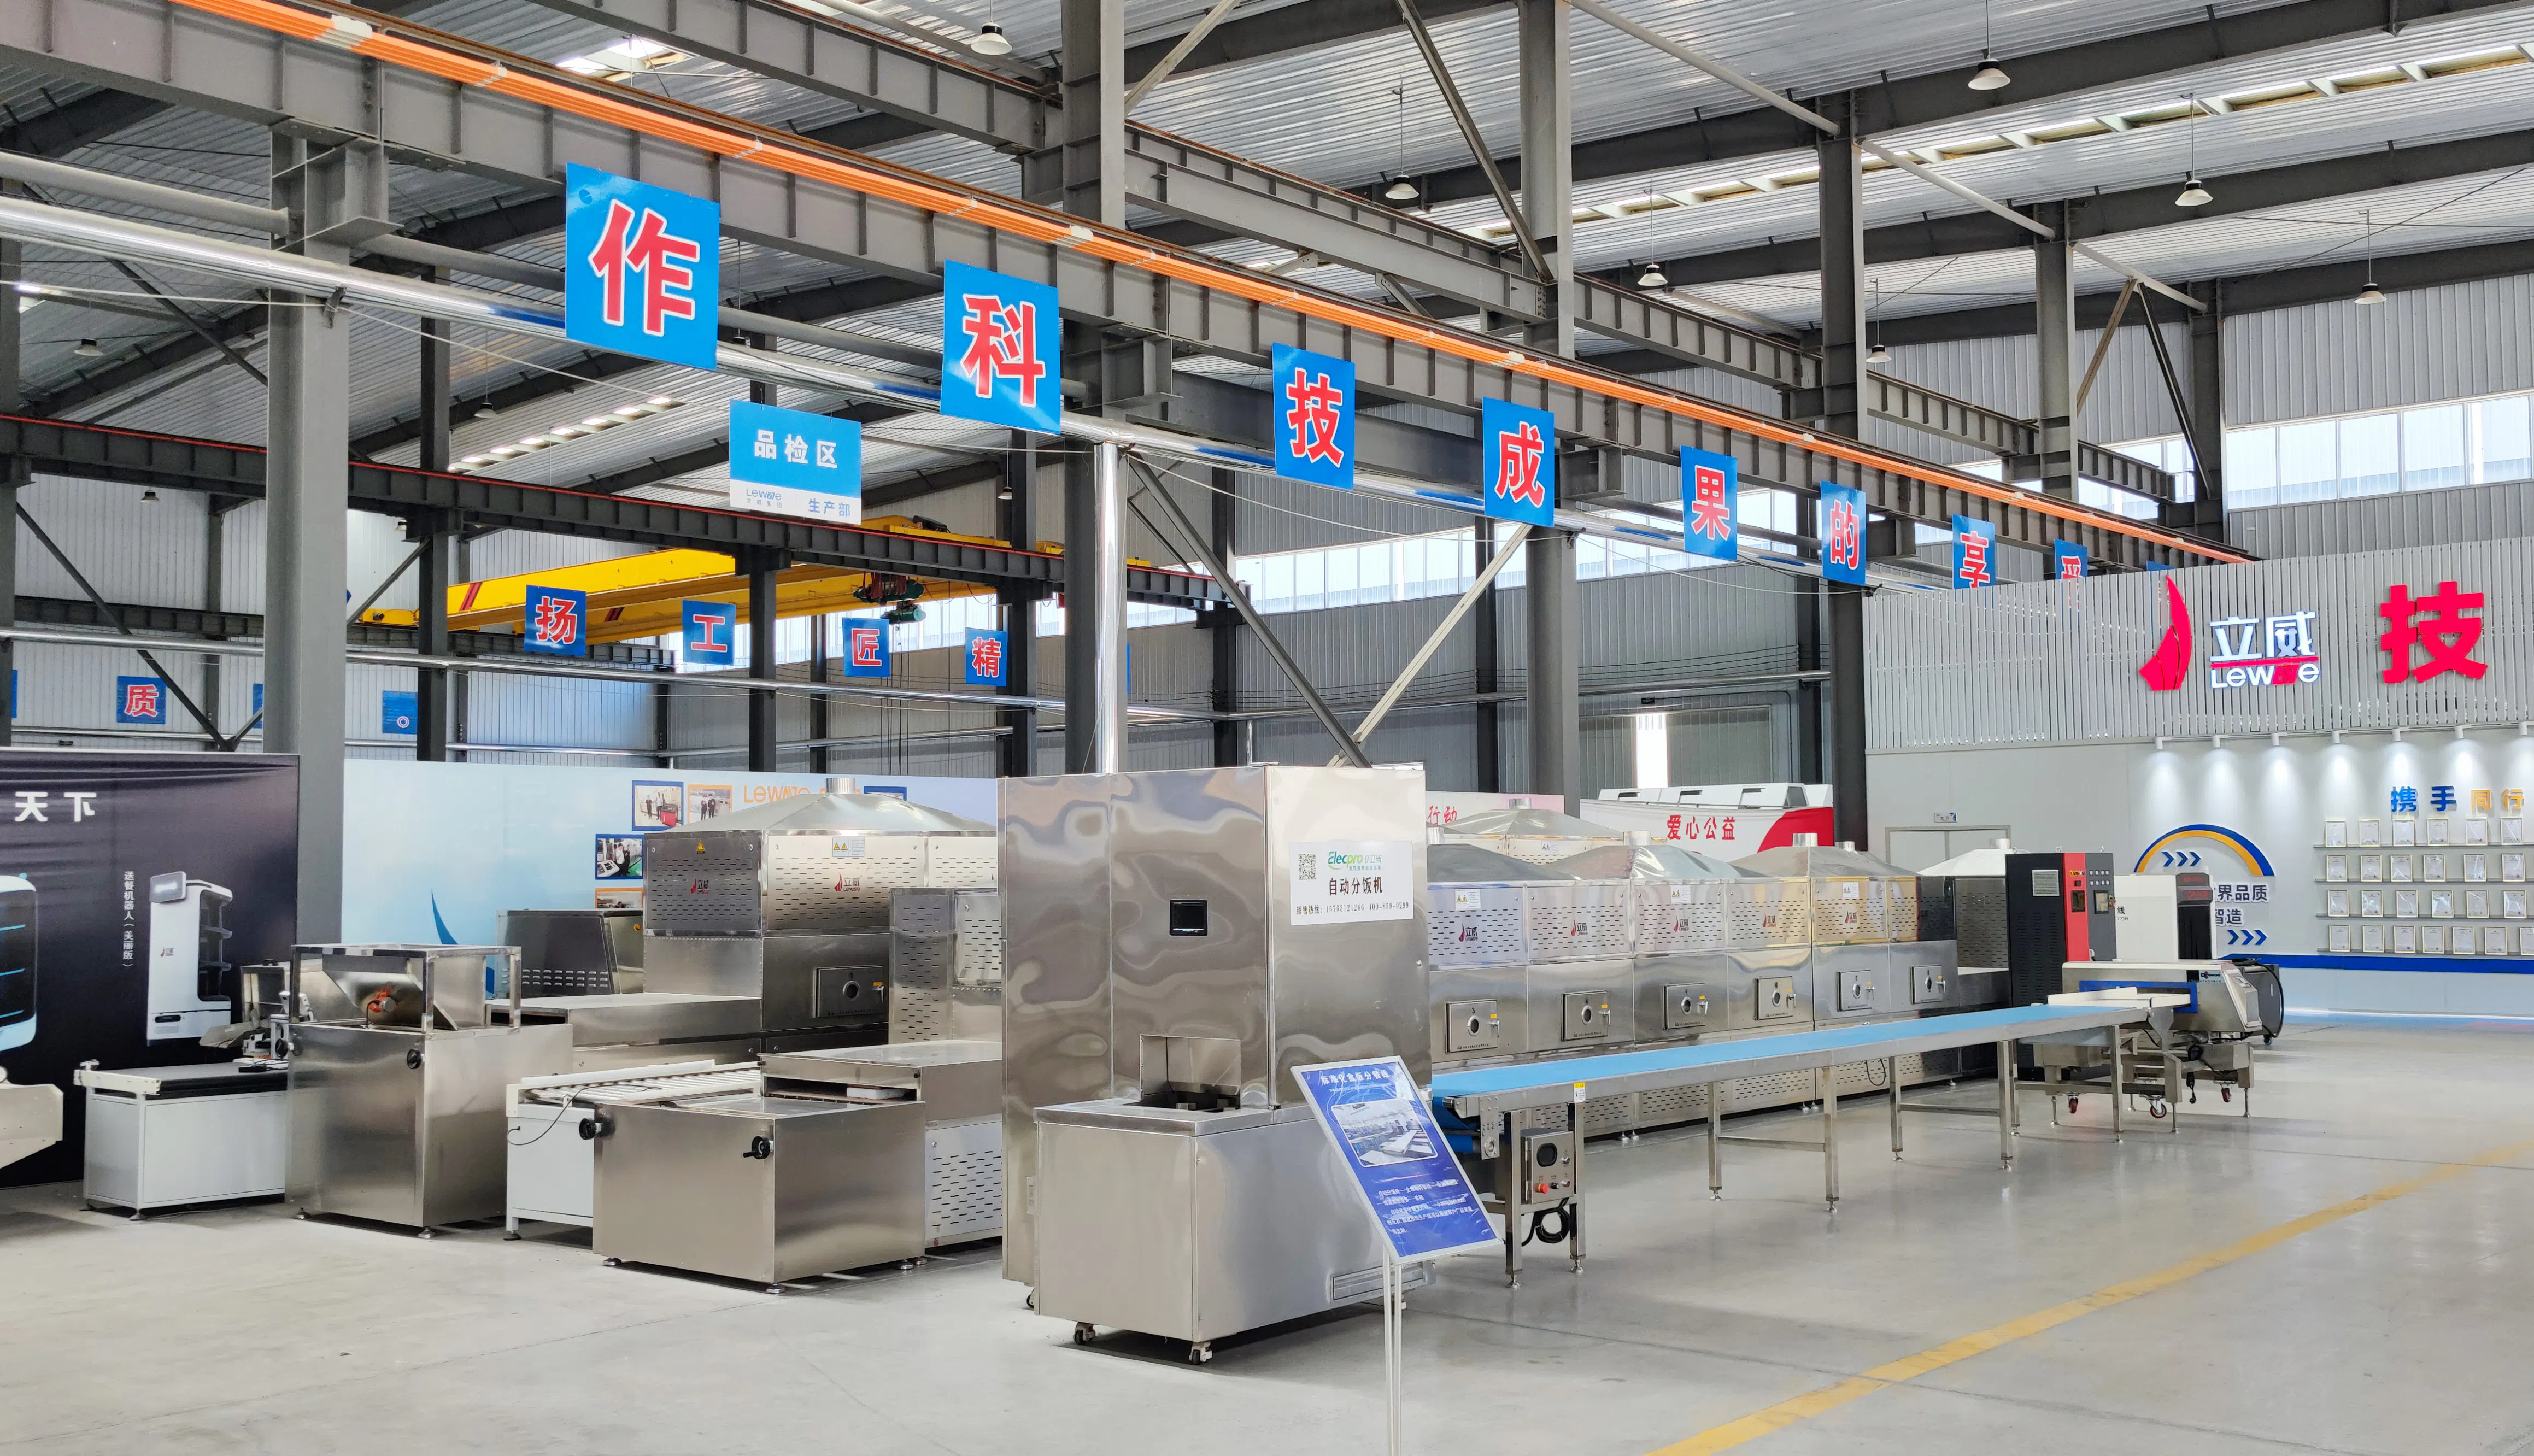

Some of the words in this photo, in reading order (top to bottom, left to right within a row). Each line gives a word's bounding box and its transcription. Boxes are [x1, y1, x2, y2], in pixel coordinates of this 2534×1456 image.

[588, 198, 700, 336] 作
[961, 293, 1045, 407] 科
[1285, 367, 1345, 468] 技
[754, 429, 837, 468] 品检区
[1494, 420, 1545, 507] 成
[808, 498, 850, 518] 生产部
[1691, 465, 1731, 541] 果
[1830, 500, 1860, 570] 的
[1960, 530, 1991, 588] 享
[536, 596, 577, 645] 扬
[690, 614, 728, 653] 工
[2209, 611, 2316, 662] 立威
[2380, 580, 2488, 684] 技
[852, 627, 883, 667] 匠
[972, 636, 1001, 678] 精
[125, 684, 160, 718] 质
[15, 791, 97, 822] 天下
[2391, 785, 2524, 812] 携手同行
[1667, 814, 1736, 841] 爱心公益
[1328, 851, 1363, 868] Elecpro
[1329, 876, 1383, 896] 自动分饭机
[2214, 884, 2268, 901] 界品质
[1326, 903, 1365, 913] 15753121266
[1369, 902, 1409, 910] 400-859-0299
